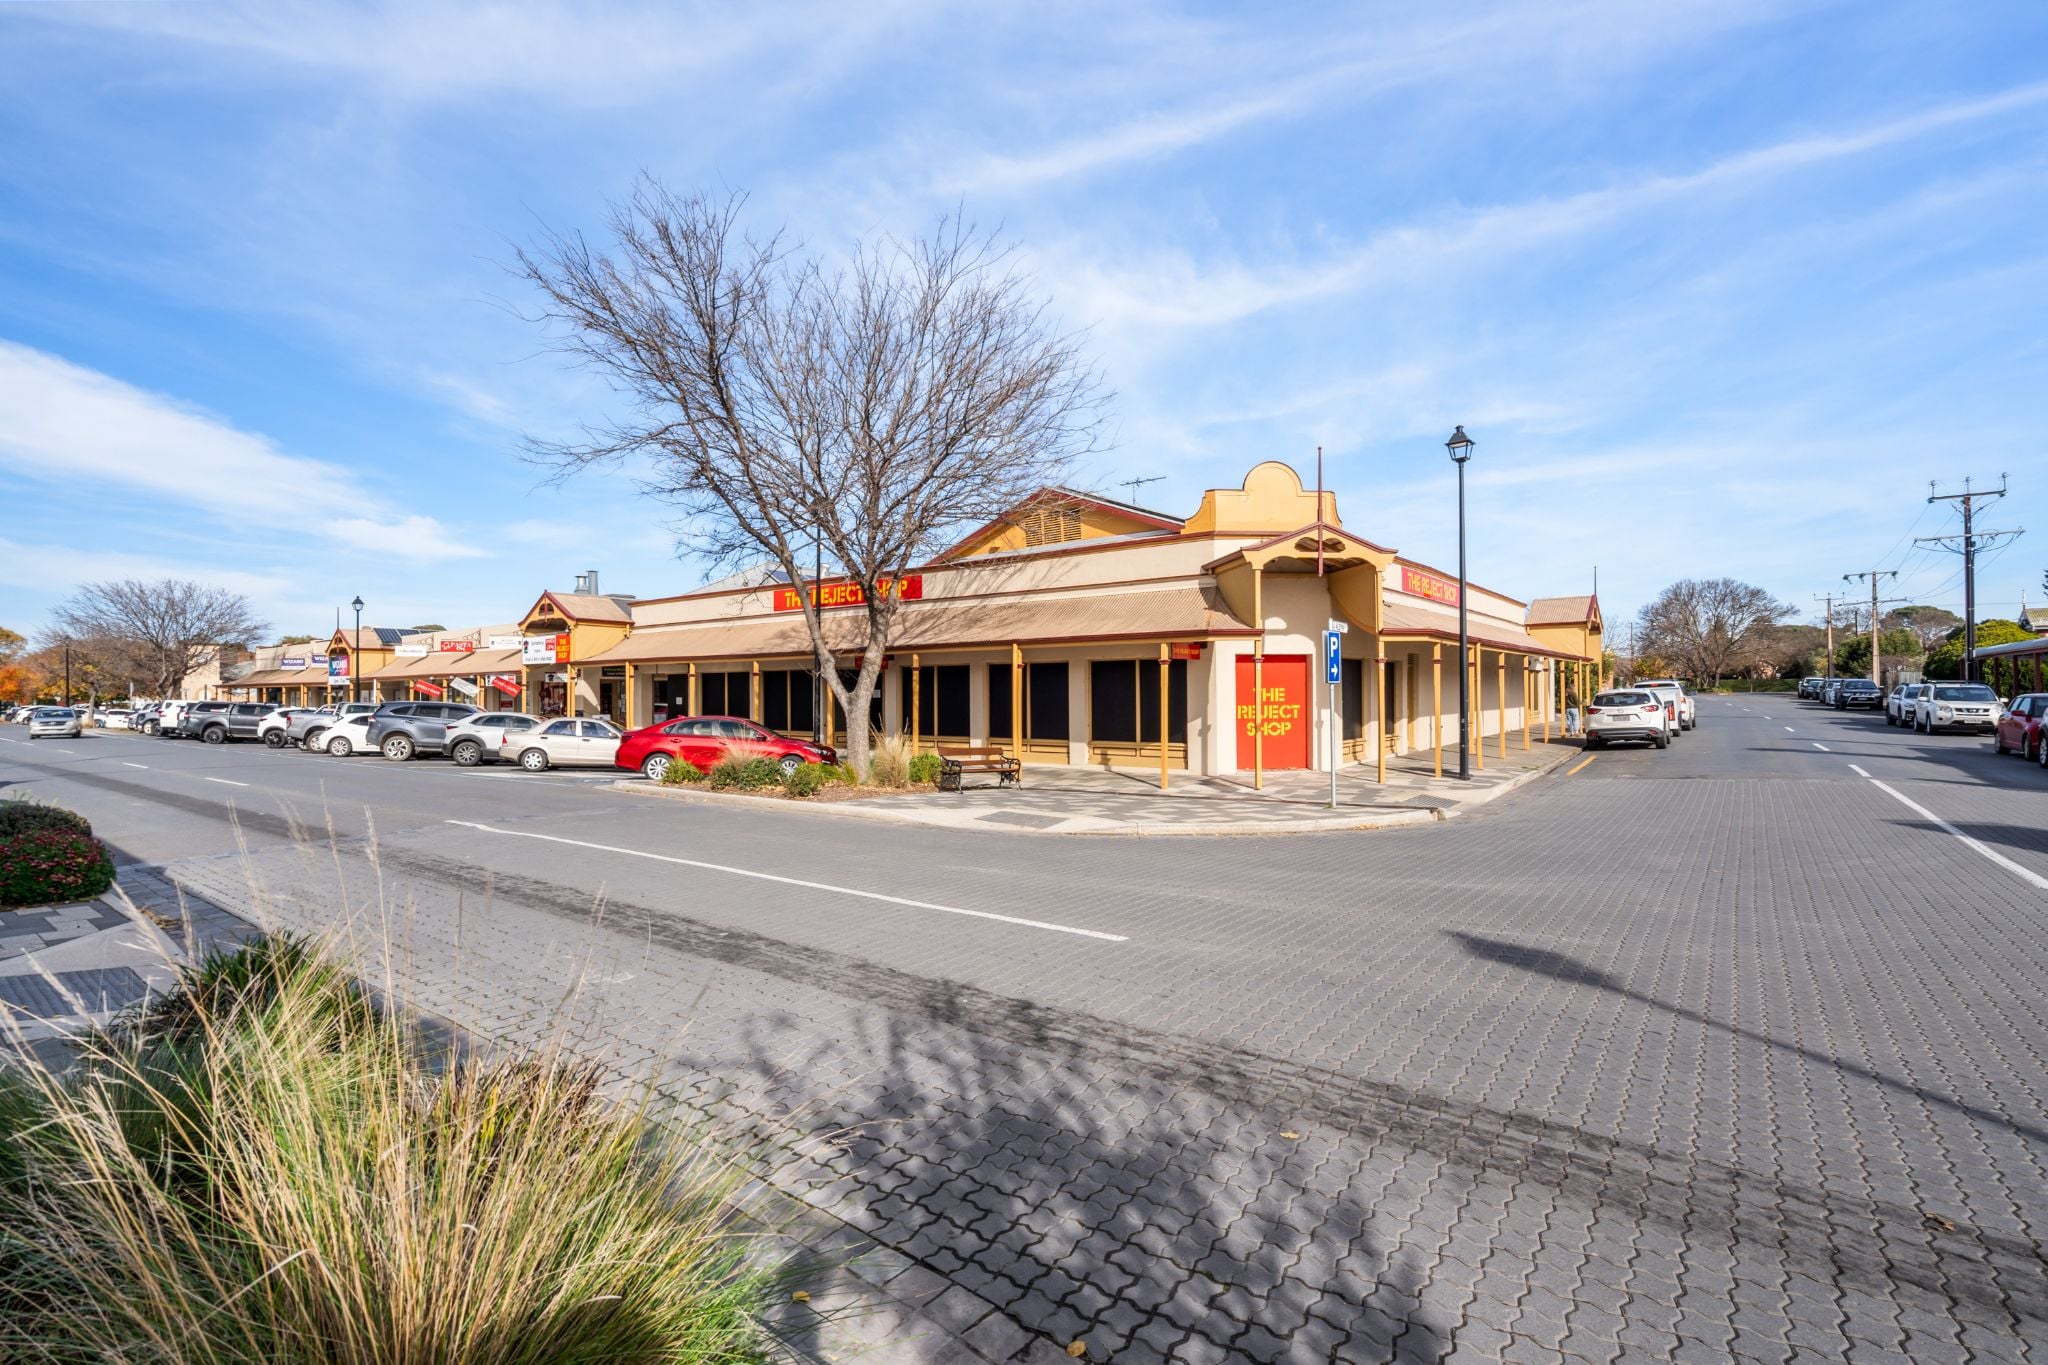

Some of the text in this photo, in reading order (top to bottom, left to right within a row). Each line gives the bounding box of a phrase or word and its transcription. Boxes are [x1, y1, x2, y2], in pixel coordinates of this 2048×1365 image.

[1407, 572, 1421, 592] THE
[1421, 577, 1443, 598] REJECT
[1330, 636, 1339, 658] P
[1251, 687, 1286, 702] HE
[1237, 704, 1301, 719] REJECT
